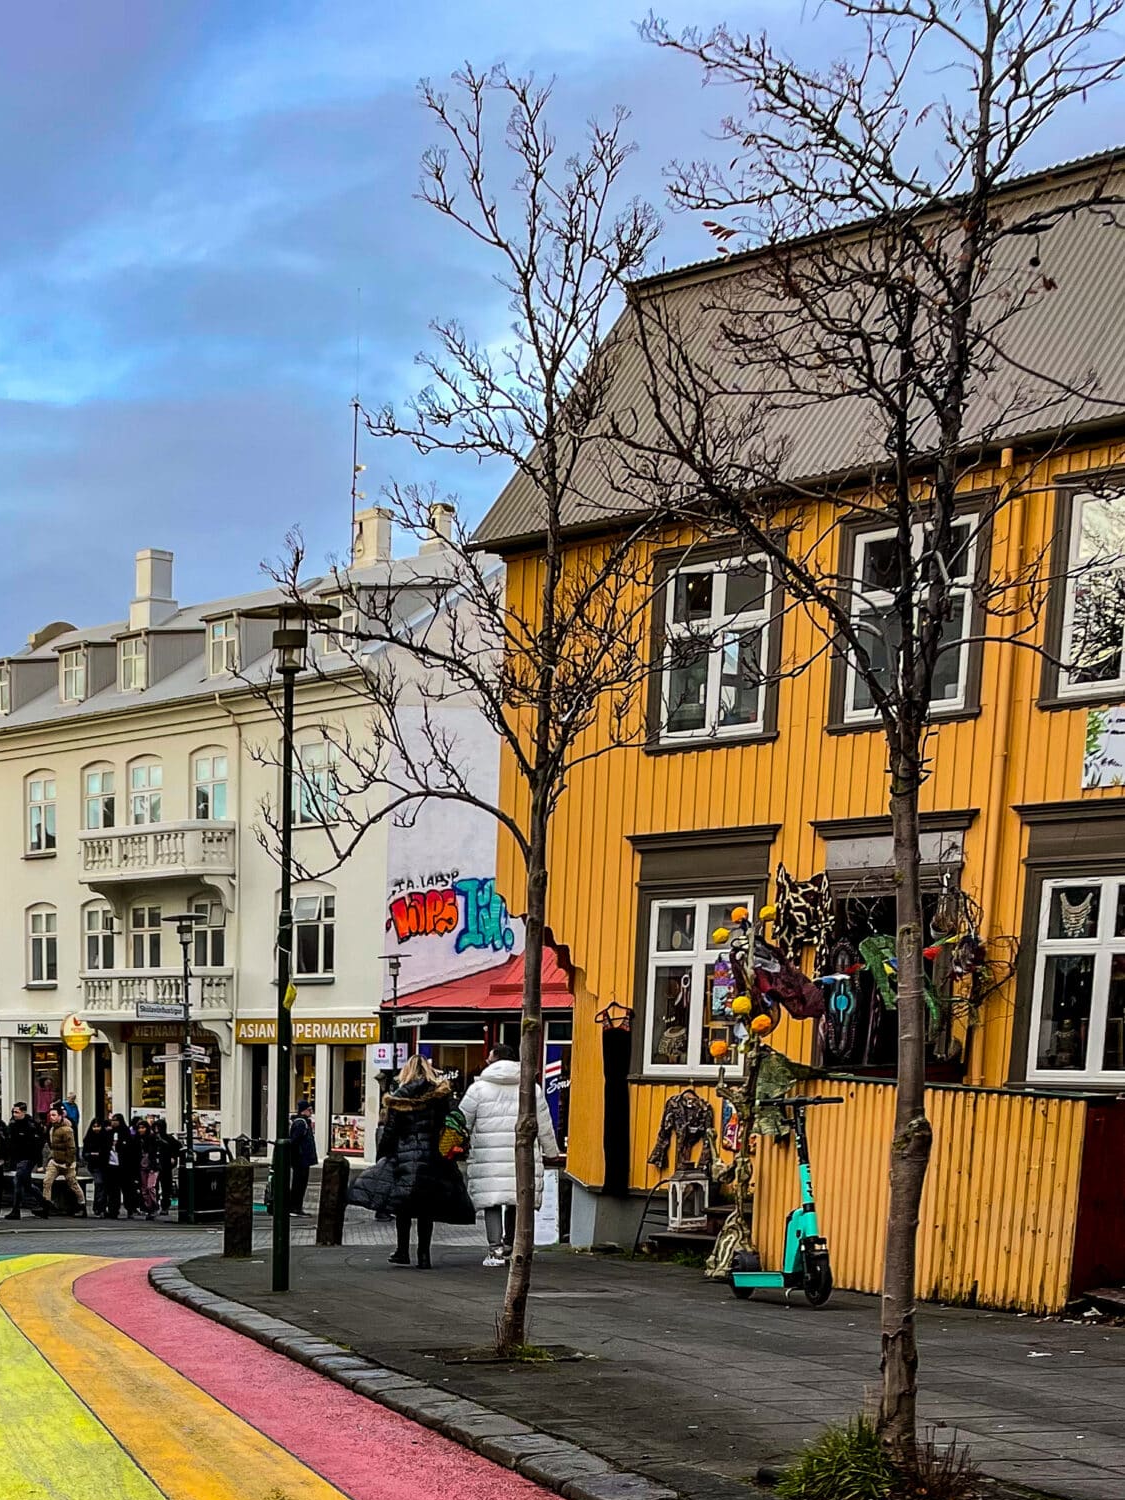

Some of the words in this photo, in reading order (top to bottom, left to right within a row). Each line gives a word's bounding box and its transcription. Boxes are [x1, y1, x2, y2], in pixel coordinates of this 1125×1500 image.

[134, 1025, 177, 1037] VIETNAM
[239, 1023, 275, 1038] ASIAN
[292, 1022, 377, 1038] PERMARKET
